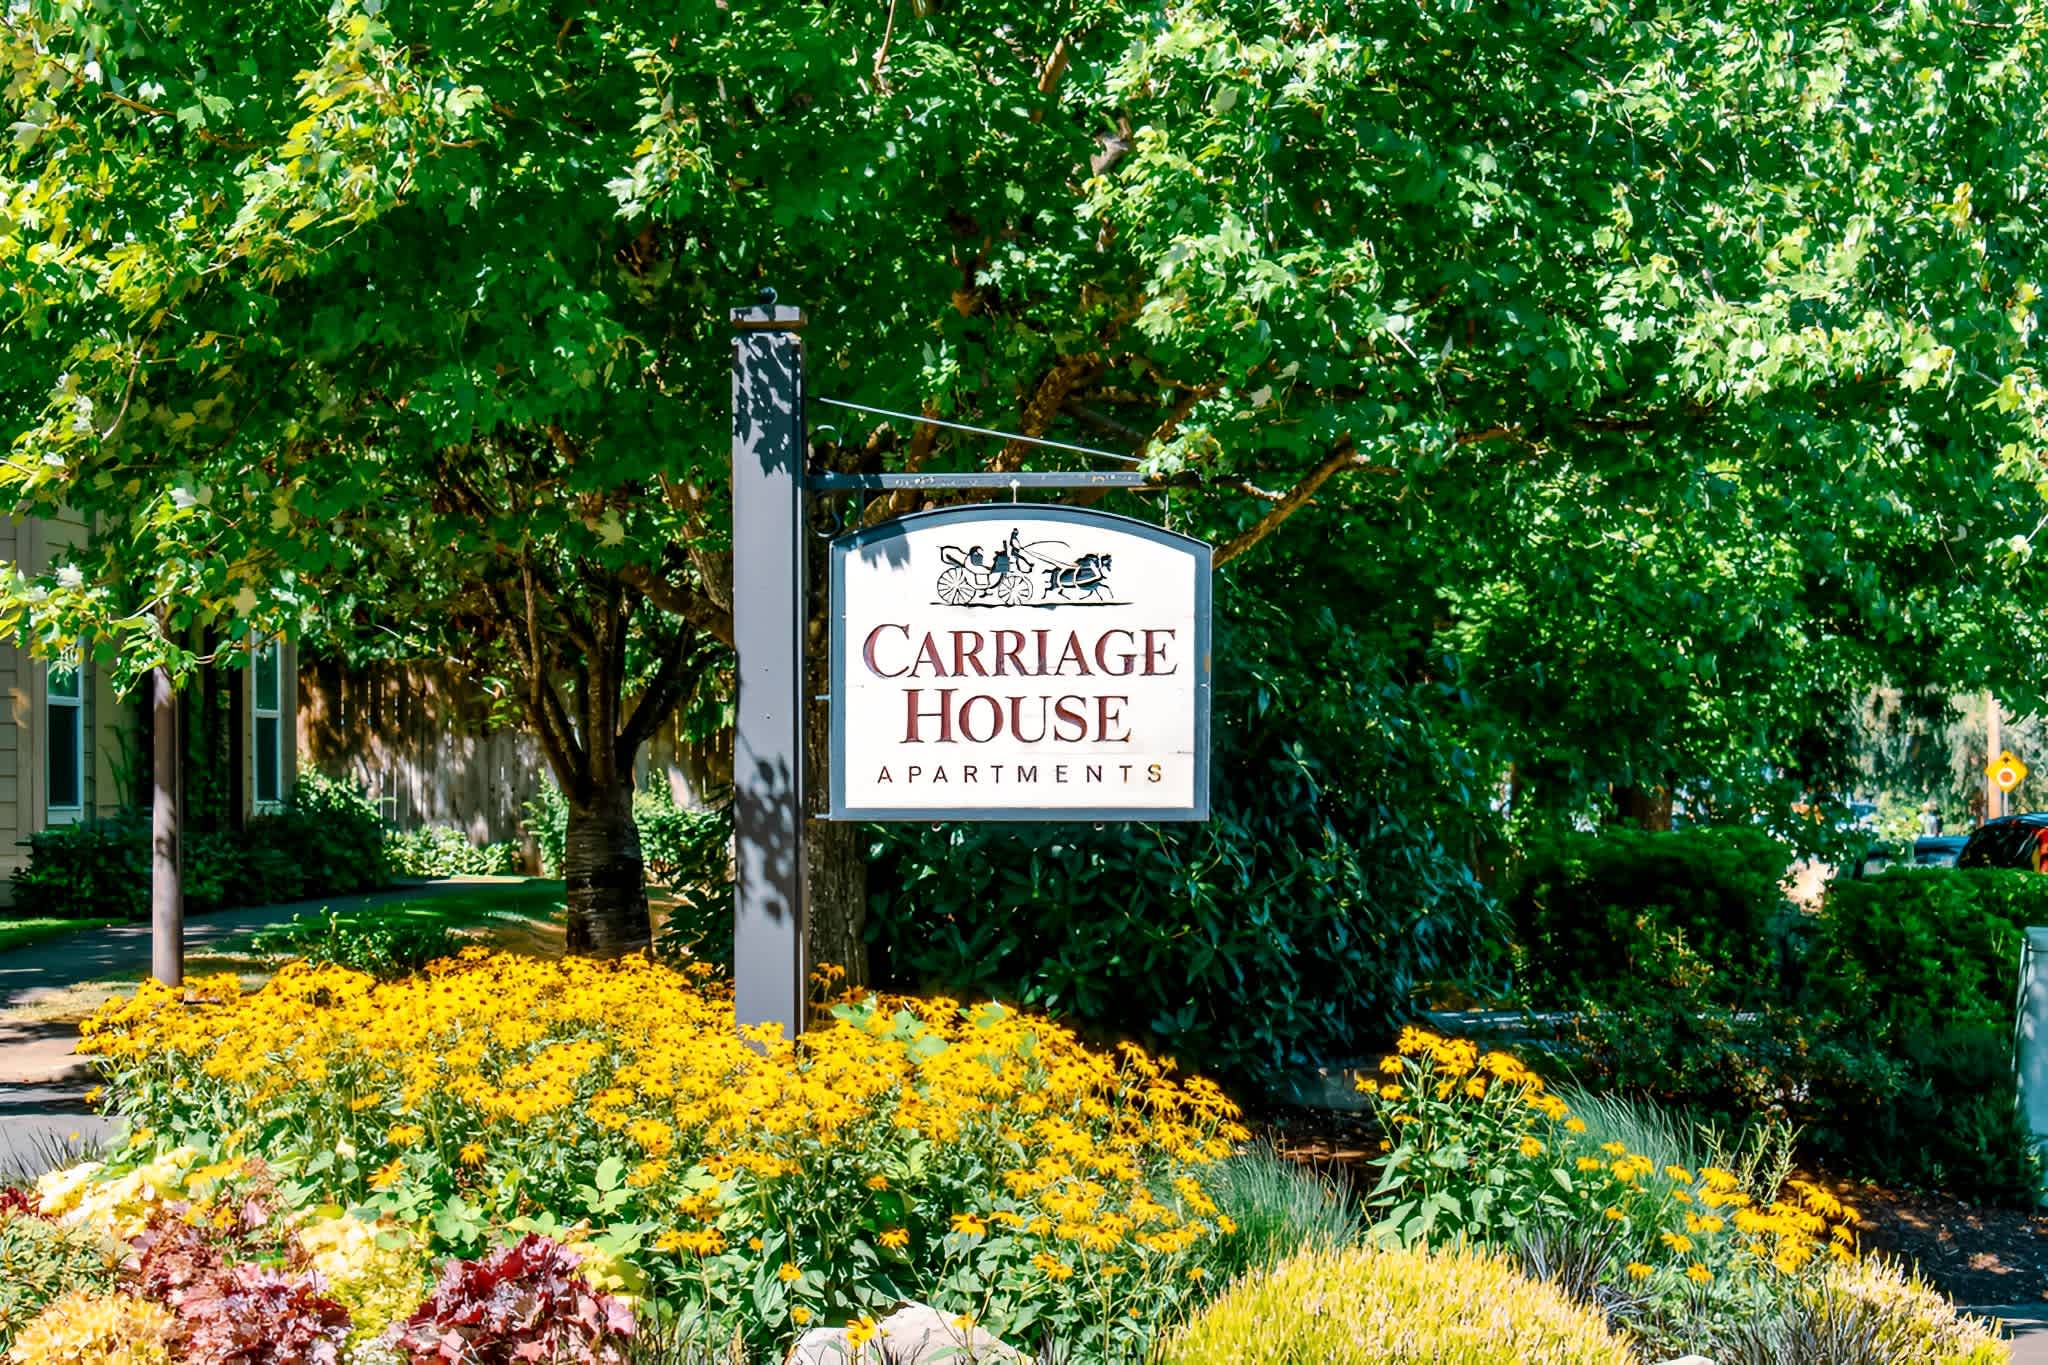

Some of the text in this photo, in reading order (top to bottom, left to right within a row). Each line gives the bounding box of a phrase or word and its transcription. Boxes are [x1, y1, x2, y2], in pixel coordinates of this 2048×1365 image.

[862, 624, 1177, 677] CARRIAGE
[900, 688, 1131, 743] HOUSE
[877, 764, 1162, 784] APARTMENTS
